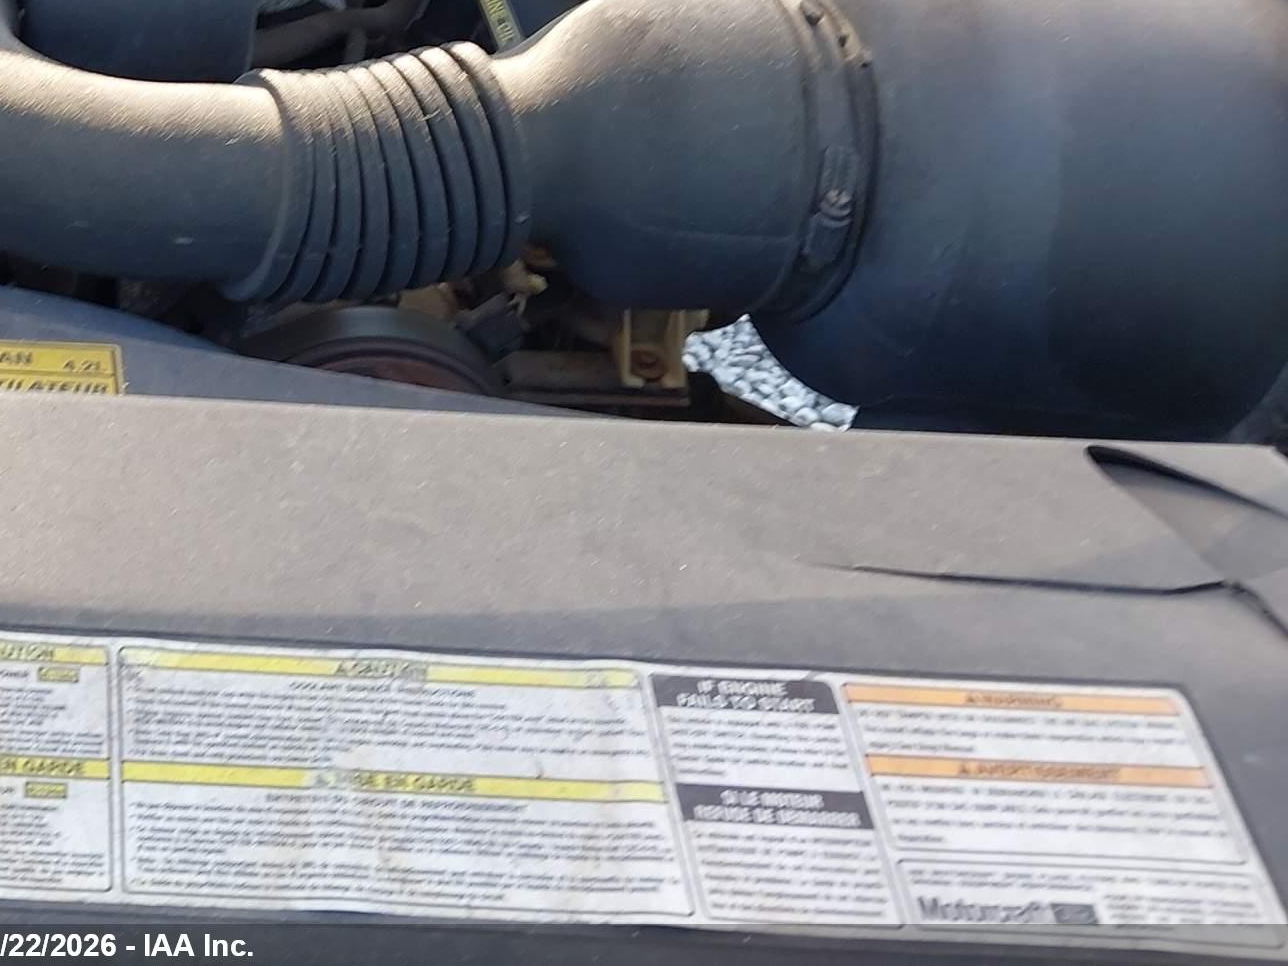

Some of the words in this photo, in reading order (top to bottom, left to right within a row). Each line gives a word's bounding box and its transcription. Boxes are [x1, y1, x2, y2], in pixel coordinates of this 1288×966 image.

[676, 691, 729, 709] FAILS
[728, 694, 757, 711] TO
[758, 696, 816, 714] START
